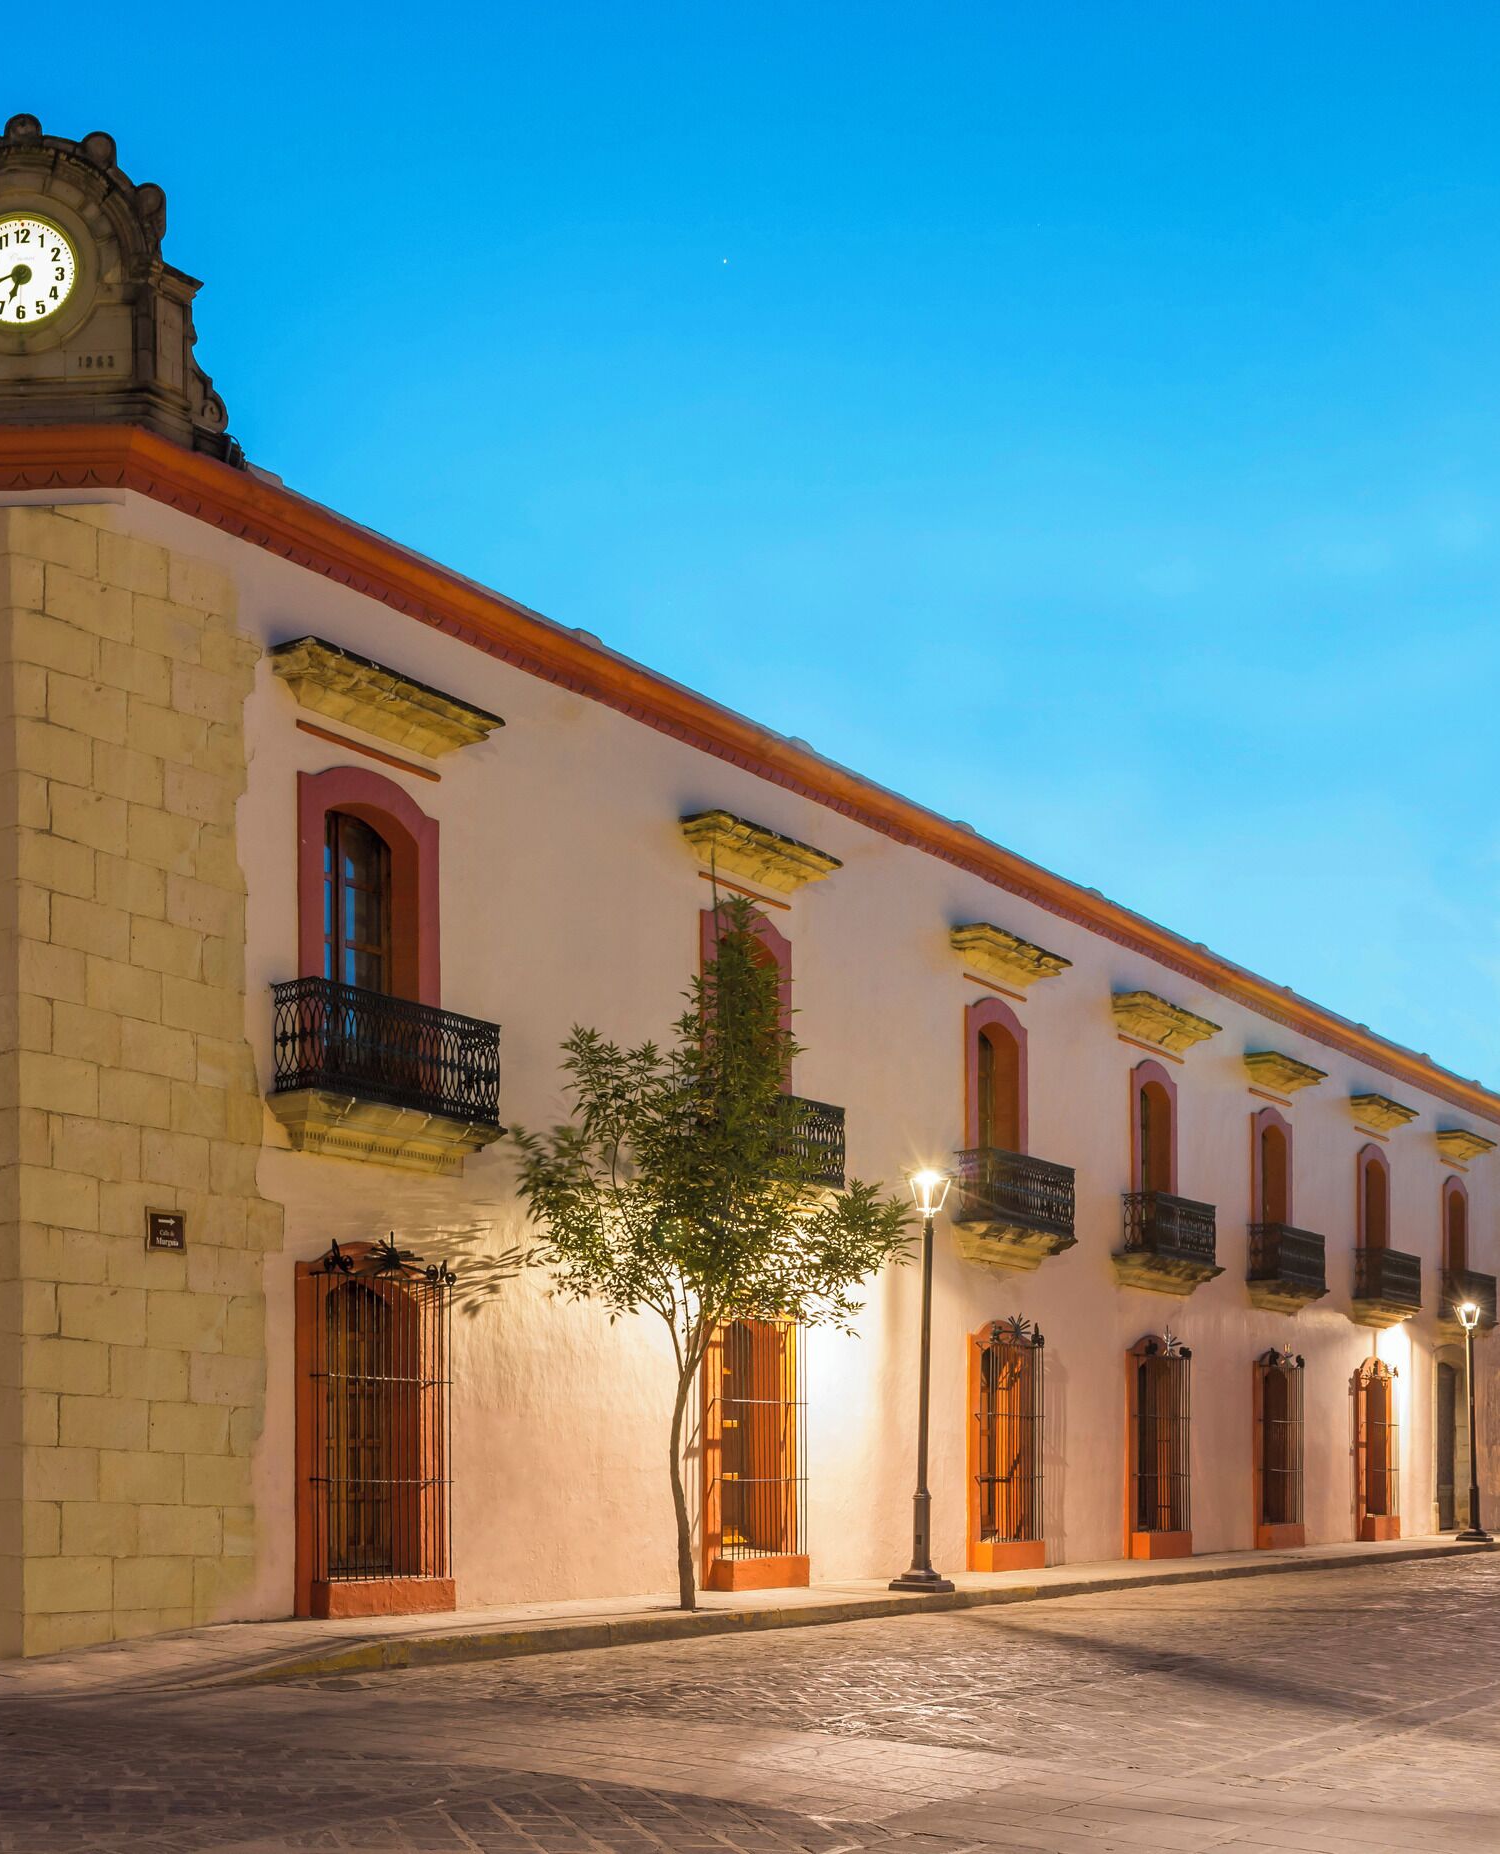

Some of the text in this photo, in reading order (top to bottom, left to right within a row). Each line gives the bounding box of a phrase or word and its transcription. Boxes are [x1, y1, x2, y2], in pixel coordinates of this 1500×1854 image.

[14, 229, 30, 243] 12
[38, 234, 45, 248] 1
[51, 247, 61, 262] 2
[55, 267, 65, 281] 3
[49, 286, 59, 300] 4
[16, 305, 26, 320] 6
[35, 300, 46, 315] 5
